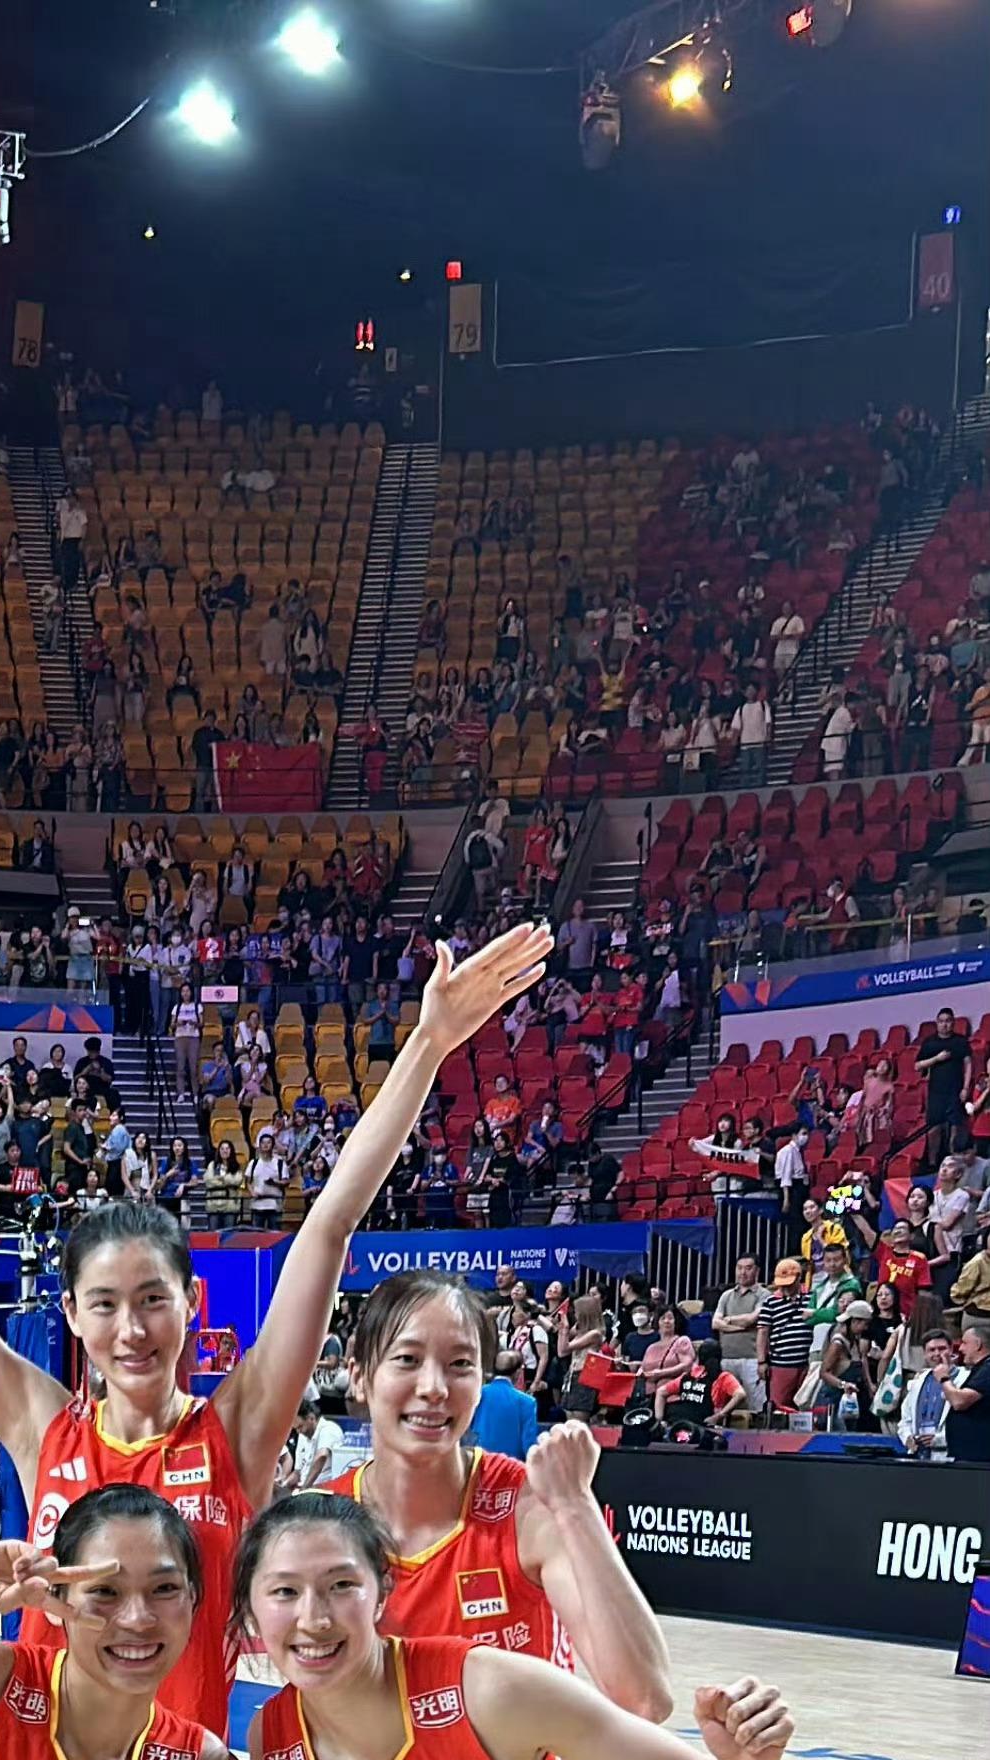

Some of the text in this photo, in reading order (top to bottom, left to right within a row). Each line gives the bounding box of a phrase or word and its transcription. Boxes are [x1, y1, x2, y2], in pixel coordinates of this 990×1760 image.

[922, 272, 950, 298] 40
[454, 323, 478, 347] 79
[18, 338, 38, 362] 78
[874, 967, 934, 986] VOLLEYBALL
[368, 1250, 504, 1273] VOLLEYBALL
[510, 1248, 546, 1258] NATIONS
[510, 1259, 542, 1269] LEAGUE
[169, 1470, 205, 1484] CHN
[473, 1491, 513, 1511] 光明
[627, 1504, 752, 1538] VOLLEYBALL
[626, 1532, 752, 1561] NATIONS LEAGUE
[876, 1520, 982, 1584] HONG
[466, 1601, 503, 1615] CHN
[10, 1681, 47, 1717] 光明
[412, 1688, 460, 1720] 光明
